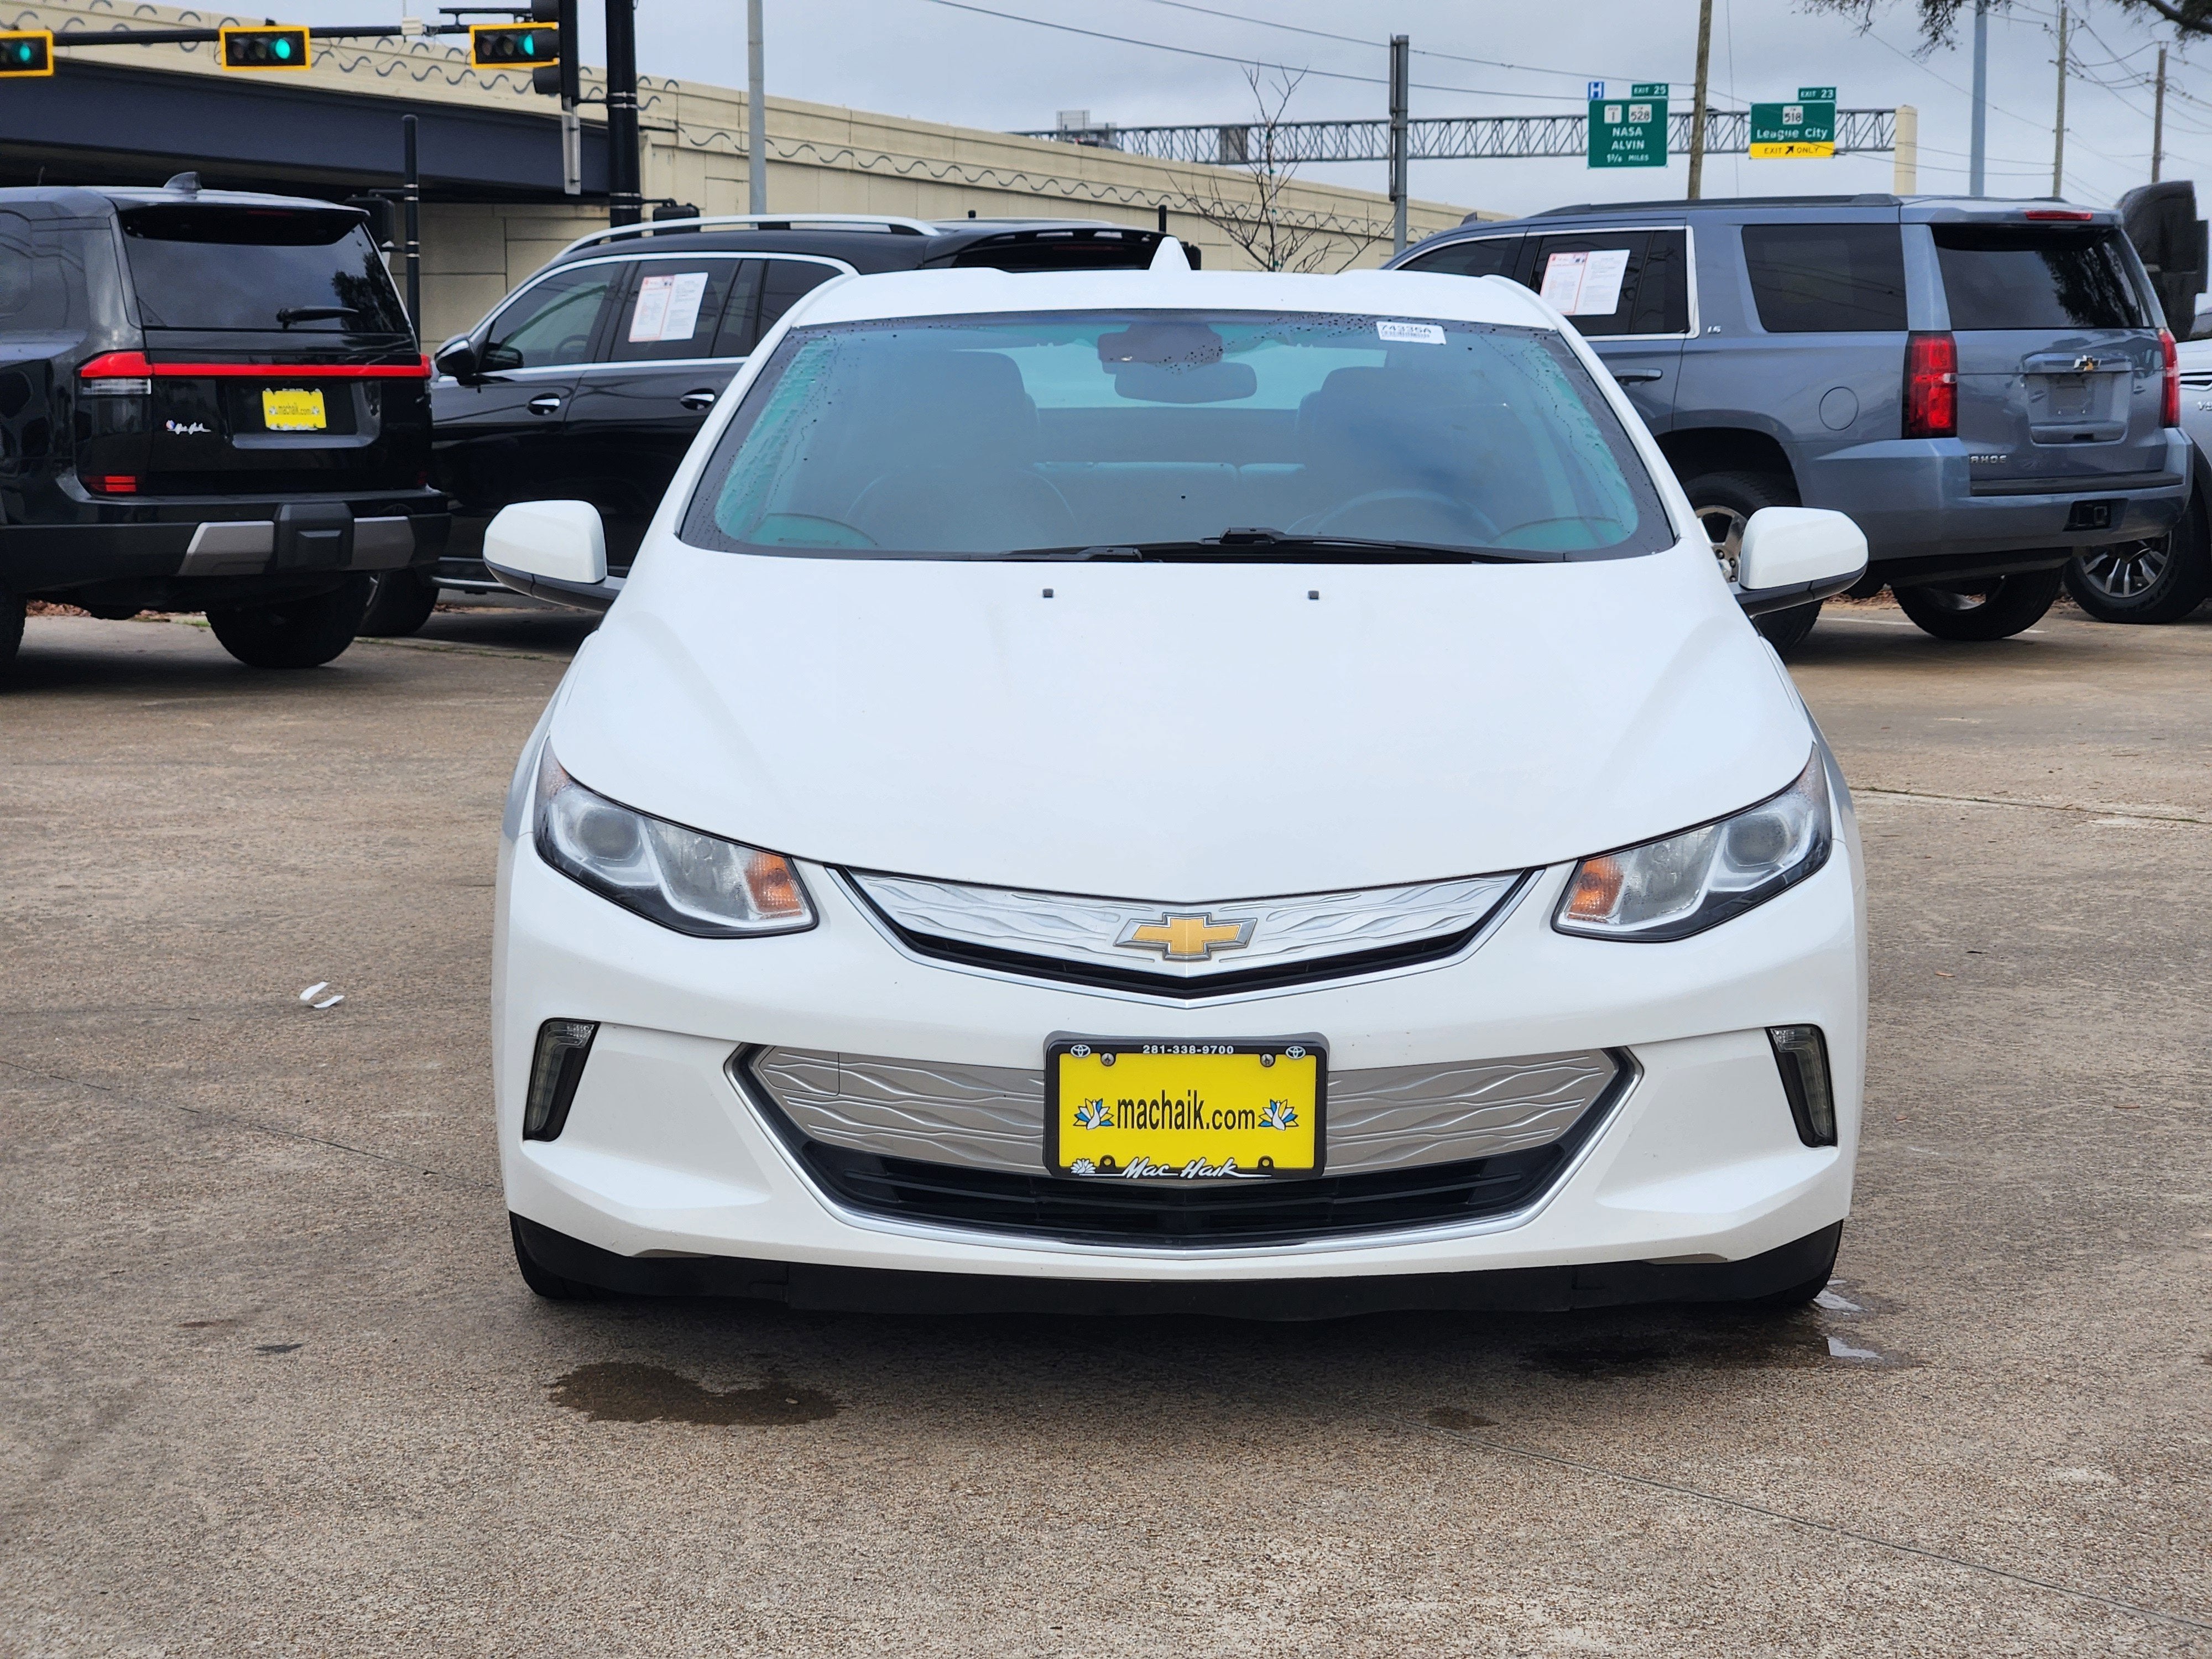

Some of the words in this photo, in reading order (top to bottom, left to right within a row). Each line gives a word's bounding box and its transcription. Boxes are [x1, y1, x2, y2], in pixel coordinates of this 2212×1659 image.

[1590, 82, 1603, 97] H
[1653, 85, 1666, 95] 25
[1820, 89, 1834, 98] 23
[1611, 112, 1615, 121] 1
[1631, 111, 1650, 121] 528
[1785, 112, 1802, 122] 518
[1612, 126, 1643, 137] NASA
[1756, 129, 1799, 140] League
[1804, 127, 1828, 140] City
[1611, 140, 1645, 150] ALVIN
[1628, 154, 1650, 162] MILES
[1968, 455, 2007, 463] AHOE
[1142, 1045, 1235, 1055] 281-338-9700
[1117, 1089, 1256, 1130] machaik.com
[1123, 1157, 1178, 1179] Mac
[1180, 1156, 1239, 1179] Haik
